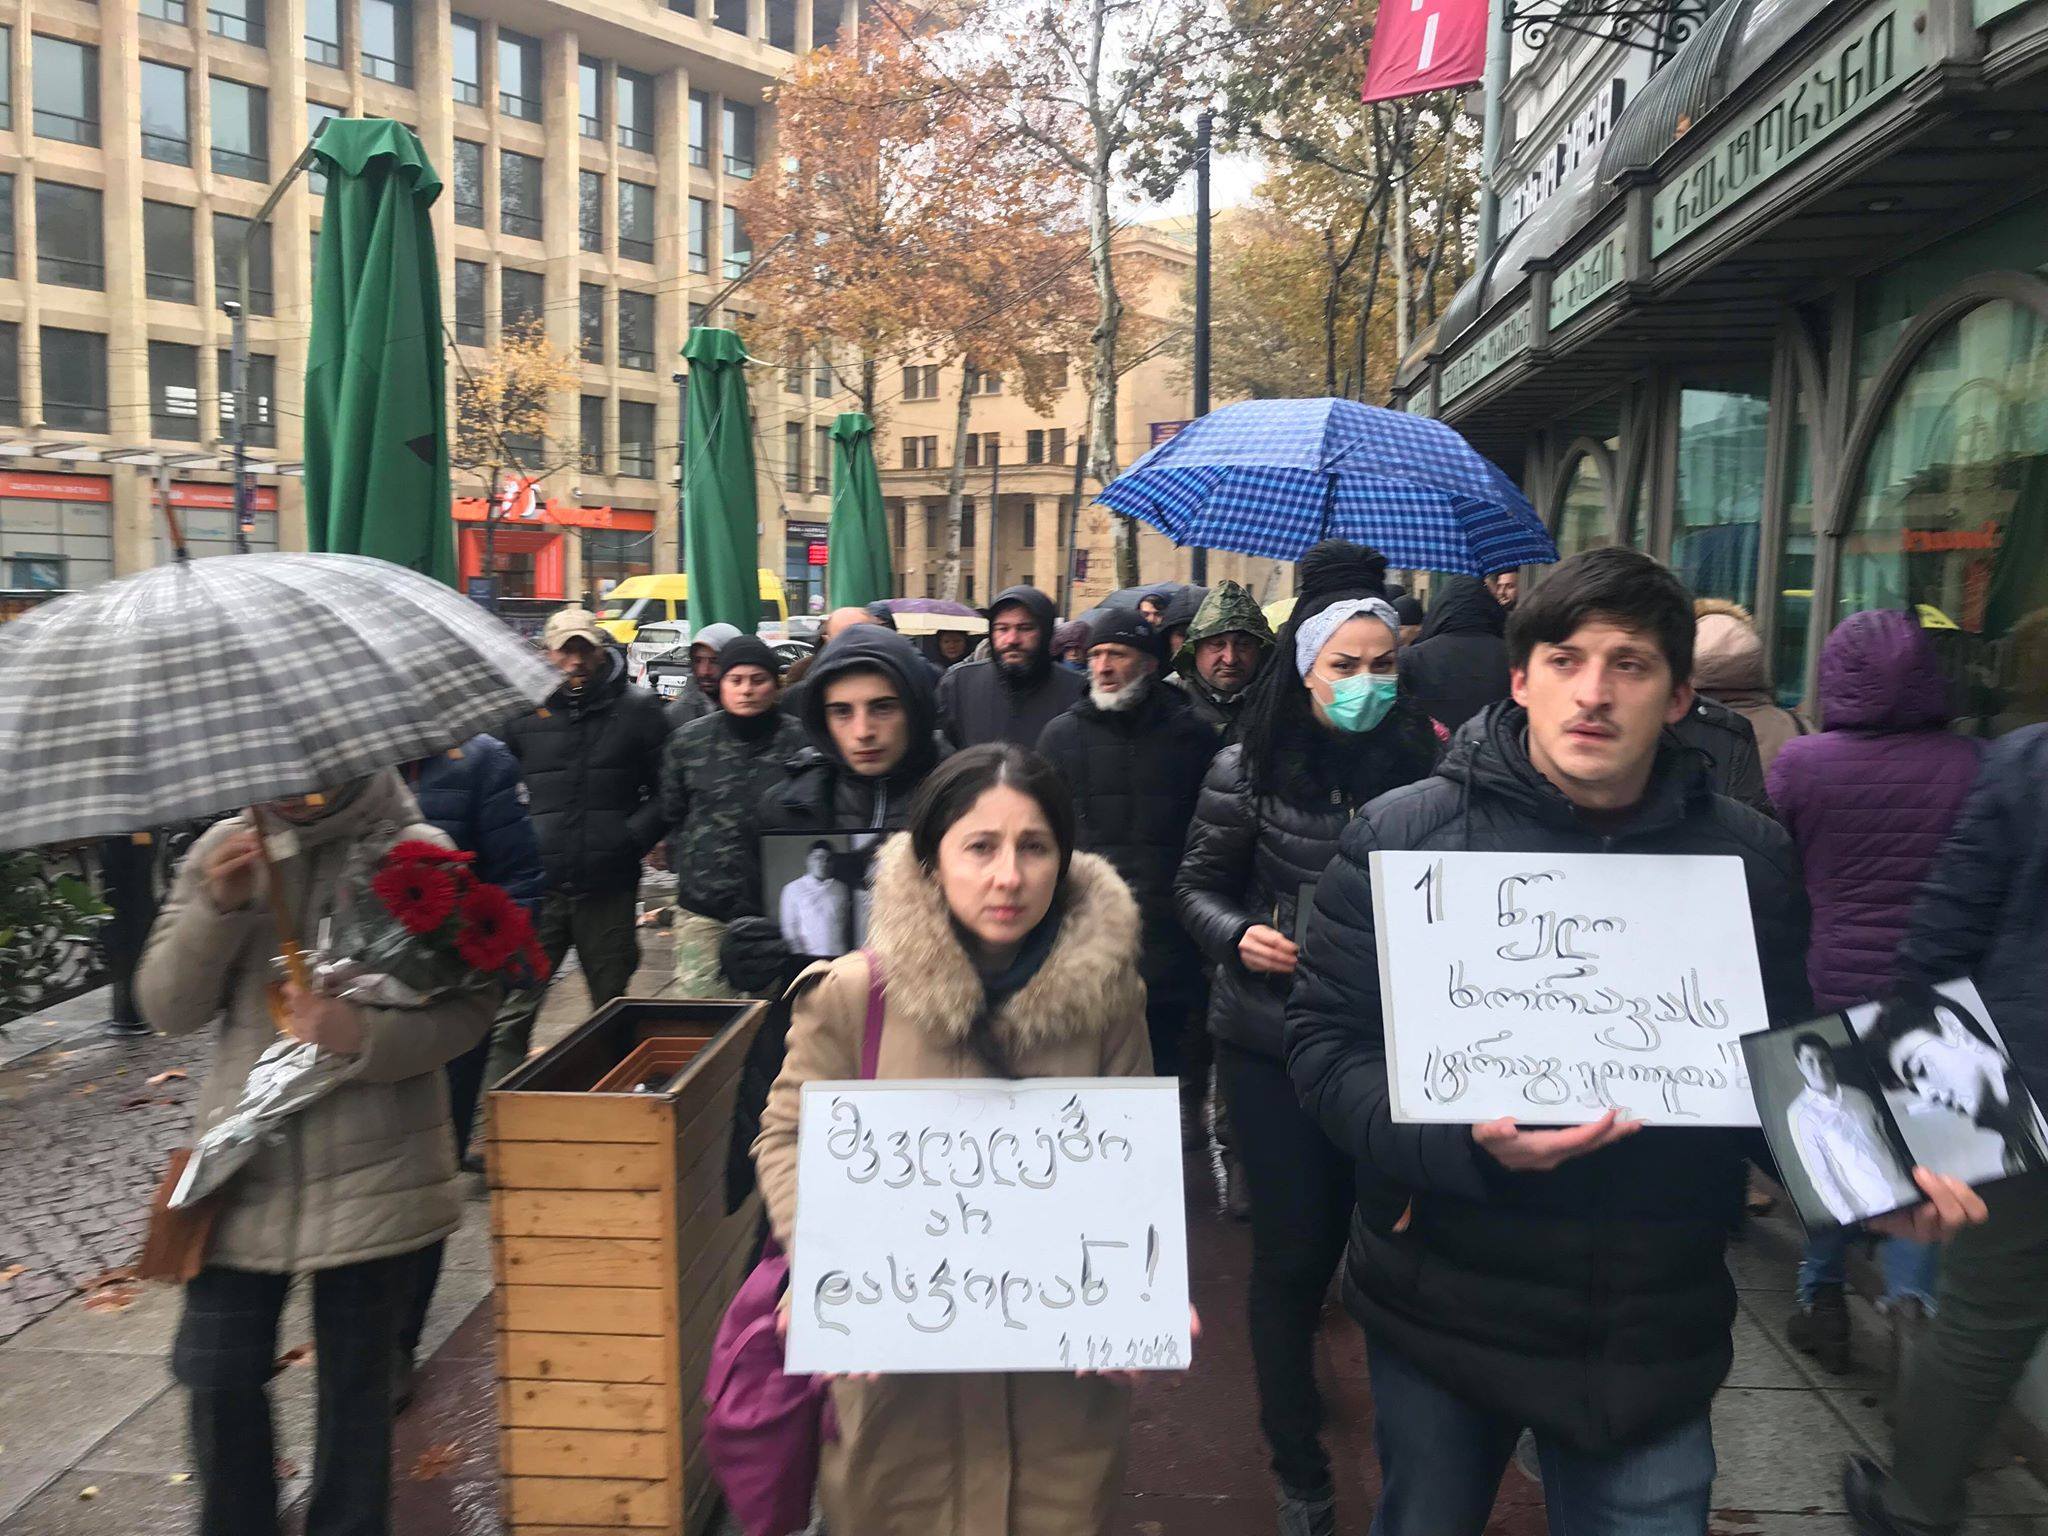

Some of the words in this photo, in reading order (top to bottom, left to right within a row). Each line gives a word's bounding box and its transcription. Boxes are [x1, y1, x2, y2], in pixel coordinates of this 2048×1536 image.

[1673, 9, 1897, 235] რესტორანი
[1567, 238, 1615, 308] ბარი
[1414, 858, 1444, 924] 1
[924, 1191, 993, 1237] არ
